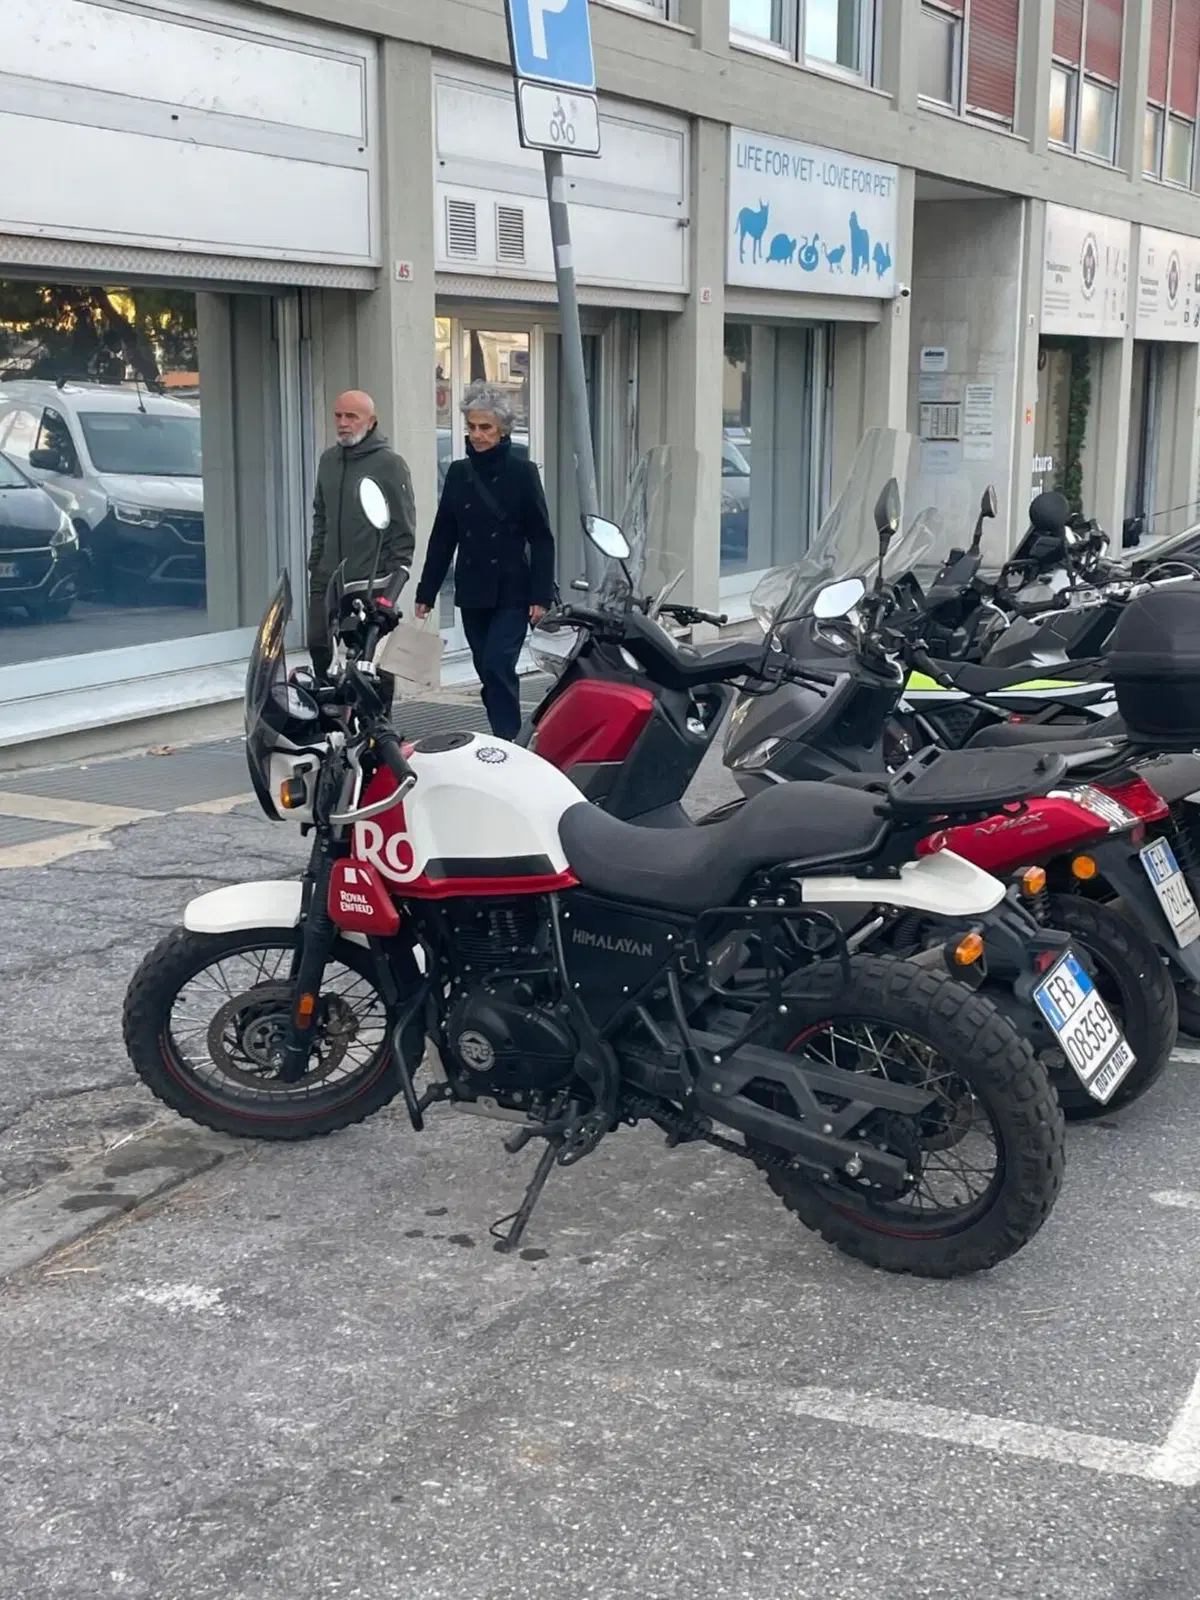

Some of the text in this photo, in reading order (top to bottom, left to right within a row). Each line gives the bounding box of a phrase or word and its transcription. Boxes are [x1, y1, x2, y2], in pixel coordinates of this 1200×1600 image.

[736, 143, 762, 172] LIFE
[765, 150, 790, 177] FOR
[792, 156, 815, 183] VET
[822, 162, 850, 190] LOVE
[851, 169, 872, 194] FOR
[399, 264, 410, 279] 45
[340, 890, 368, 904] ROYAL
[340, 901, 374, 916] ENFIELD
[572, 928, 653, 957] HIMALAYAN
[1046, 975, 1077, 1019] FB
[1066, 1000, 1114, 1070] 08369
